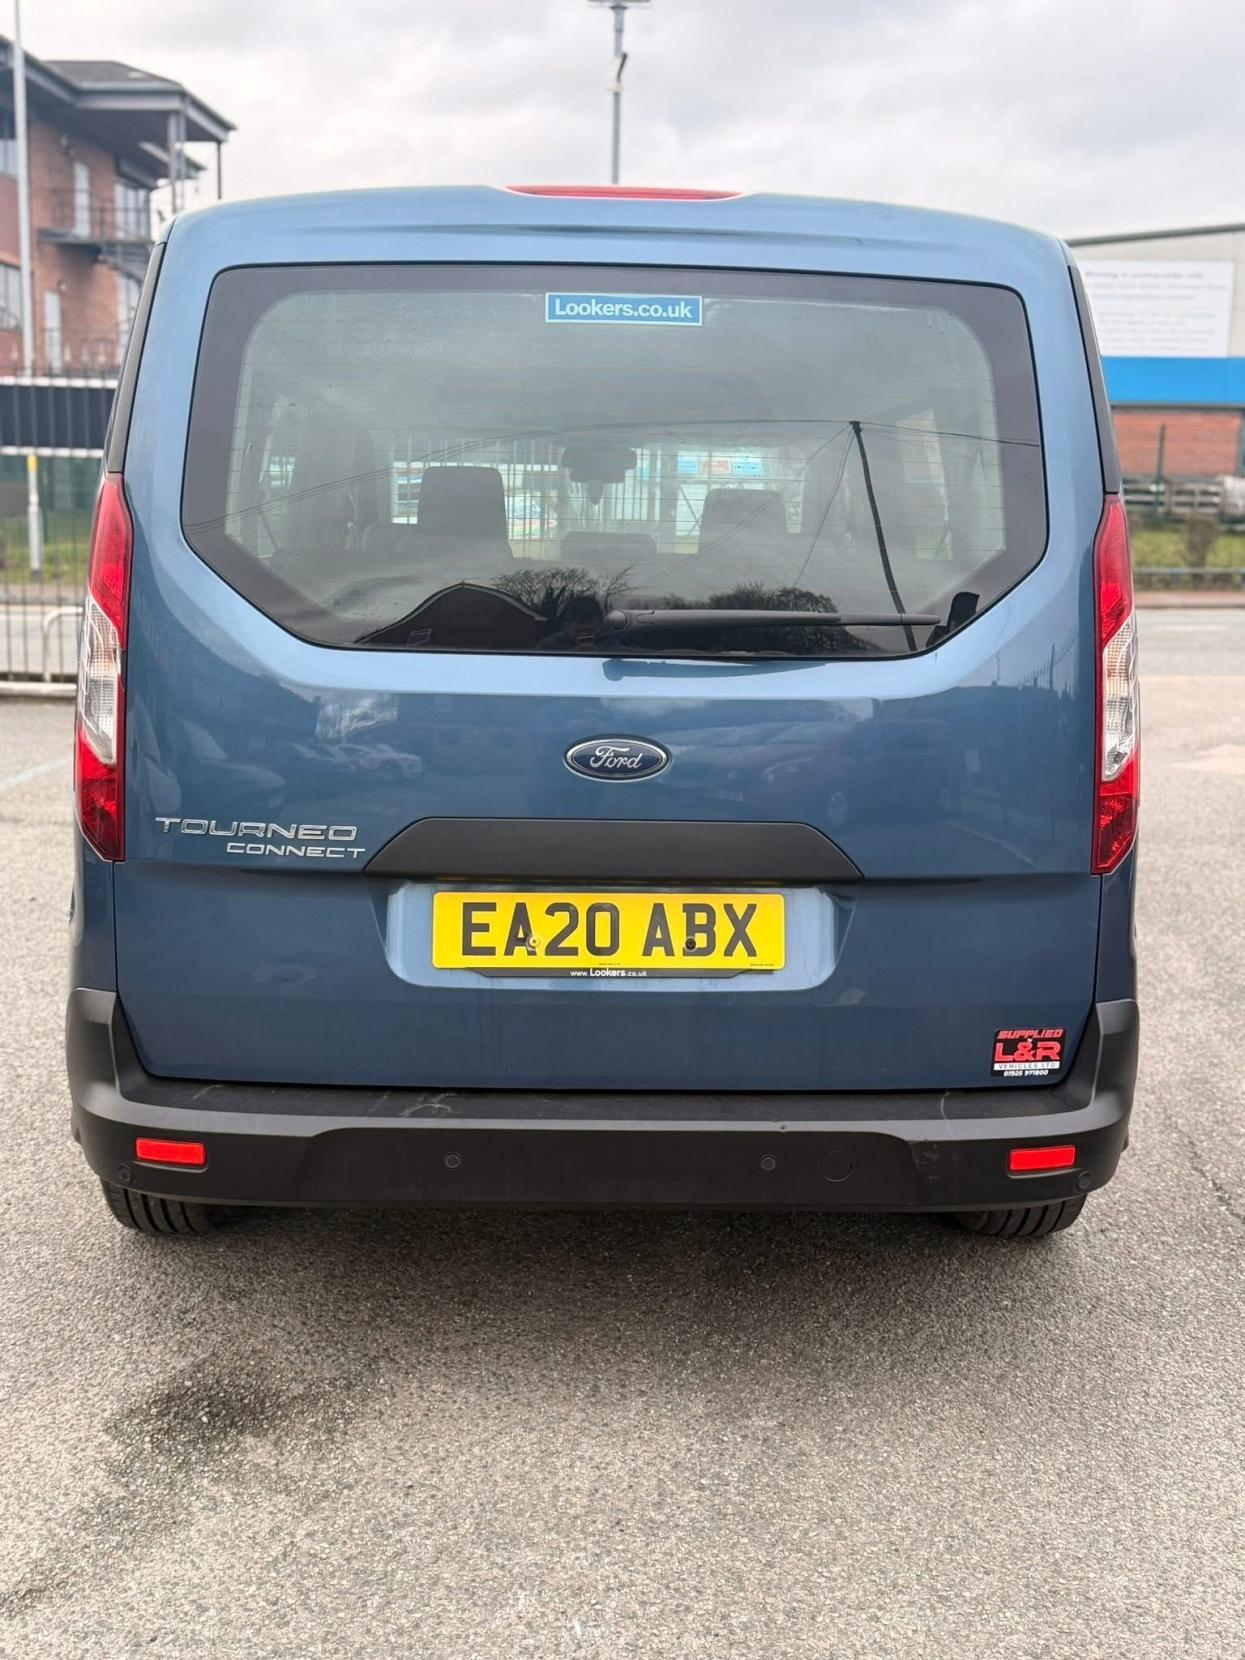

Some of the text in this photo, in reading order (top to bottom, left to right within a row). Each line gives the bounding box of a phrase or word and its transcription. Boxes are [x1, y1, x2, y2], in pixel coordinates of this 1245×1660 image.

[555, 298, 693, 319] Lookers.co.uk
[589, 745, 643, 769] Ford
[155, 817, 358, 841] TOURNEO
[226, 842, 366, 859] CONNECT
[462, 901, 758, 958] EA20 ABX
[569, 968, 648, 977] www.Lookers.co.uk
[997, 1028, 1064, 1039] SUPPLIED
[995, 1041, 1061, 1062] L&R
